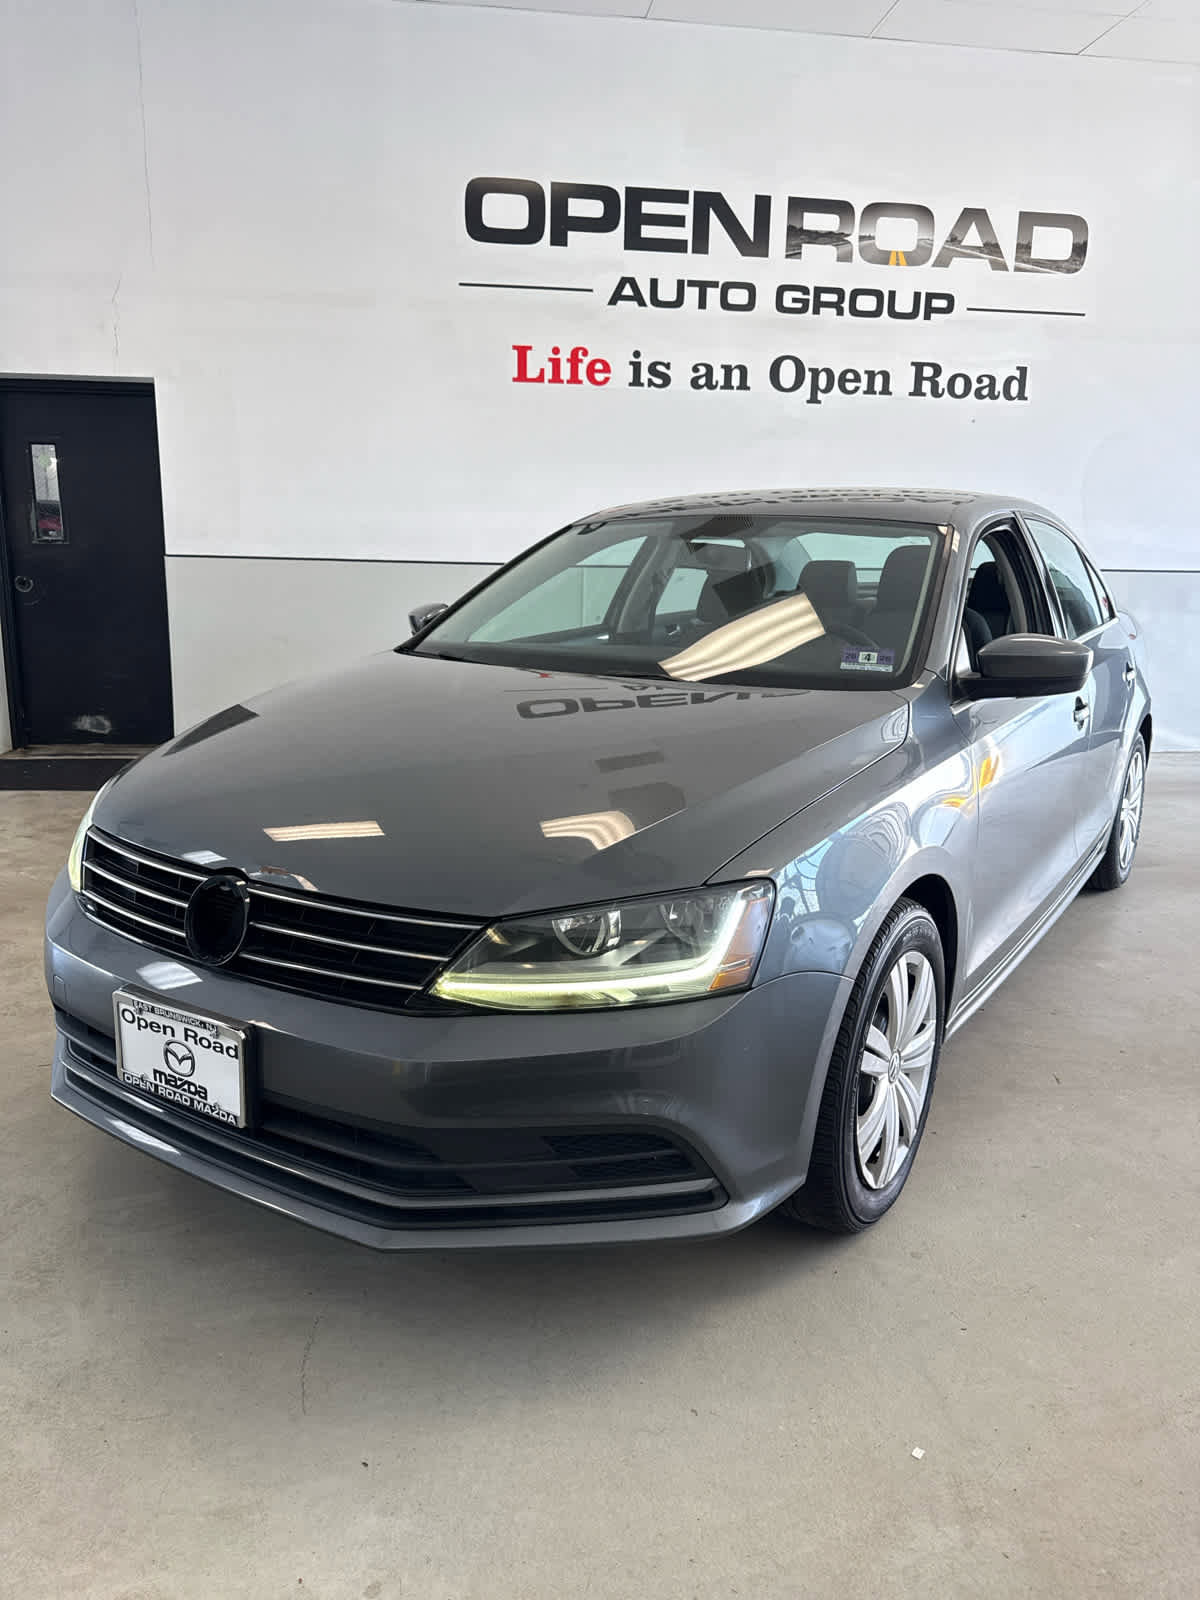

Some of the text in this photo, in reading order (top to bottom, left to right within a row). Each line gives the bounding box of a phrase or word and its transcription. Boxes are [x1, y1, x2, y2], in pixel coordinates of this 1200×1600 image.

[465, 177, 1089, 274] OPEN ROAD
[608, 276, 955, 321] AUTO GROUP
[511, 345, 1028, 405] Life is an Open Road
[133, 1000, 152, 1012] EAST
[121, 1008, 239, 1059] Open Road
[124, 1073, 237, 1126] OPEN ROAD MAZDA
